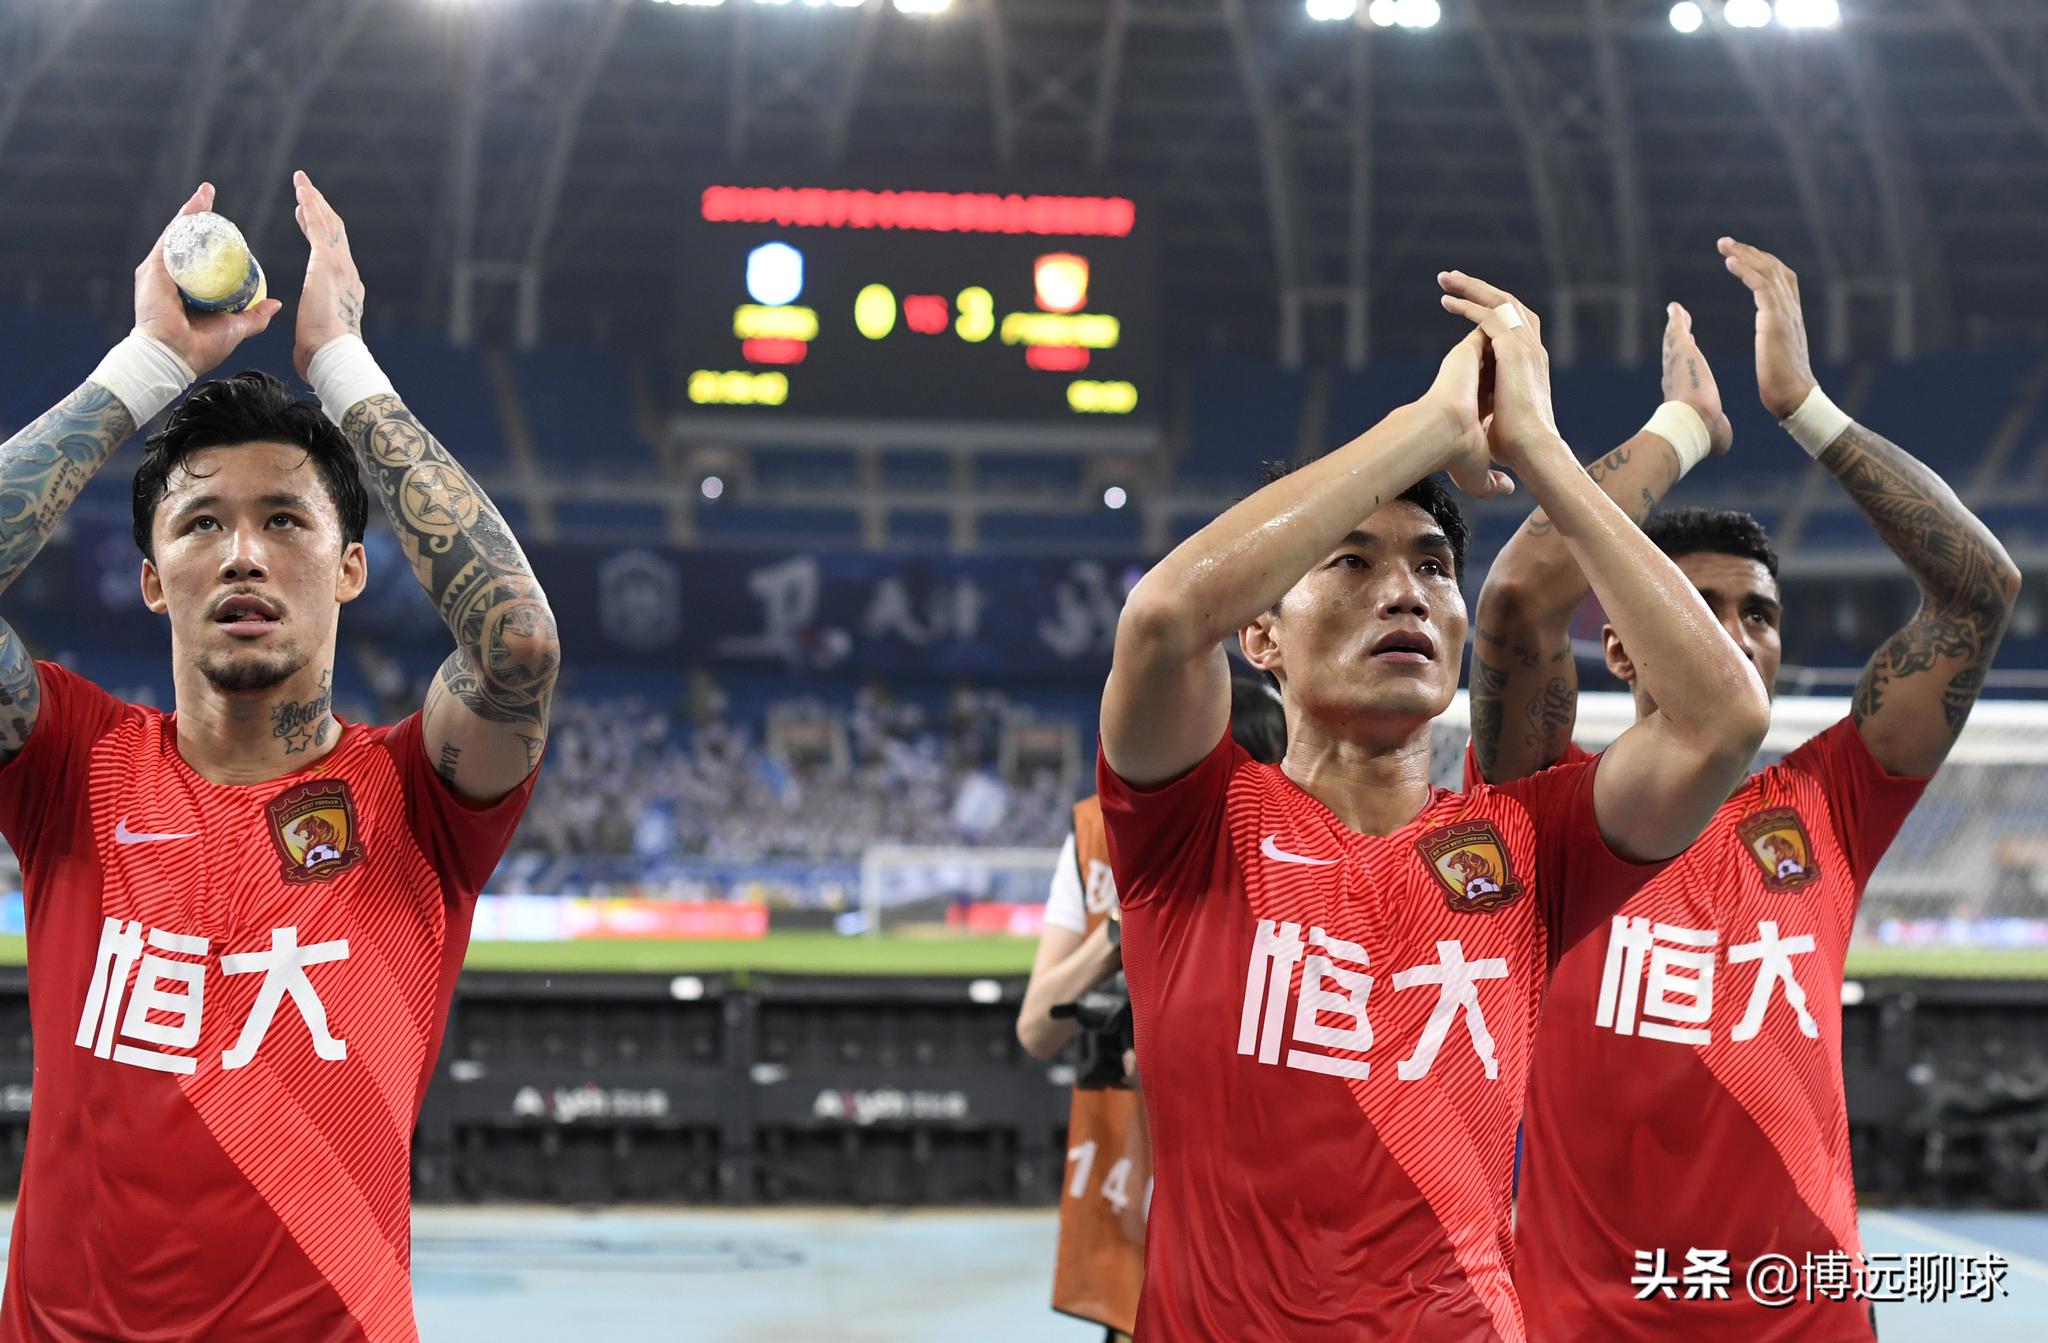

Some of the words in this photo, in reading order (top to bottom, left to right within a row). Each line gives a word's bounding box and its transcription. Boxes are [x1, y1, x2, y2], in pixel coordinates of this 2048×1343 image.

[74, 916, 350, 1075] 恒大
[1237, 918, 1509, 1081] 恒大
[1595, 915, 1819, 1046] 恒大
[1067, 1139, 1154, 1224] 14
